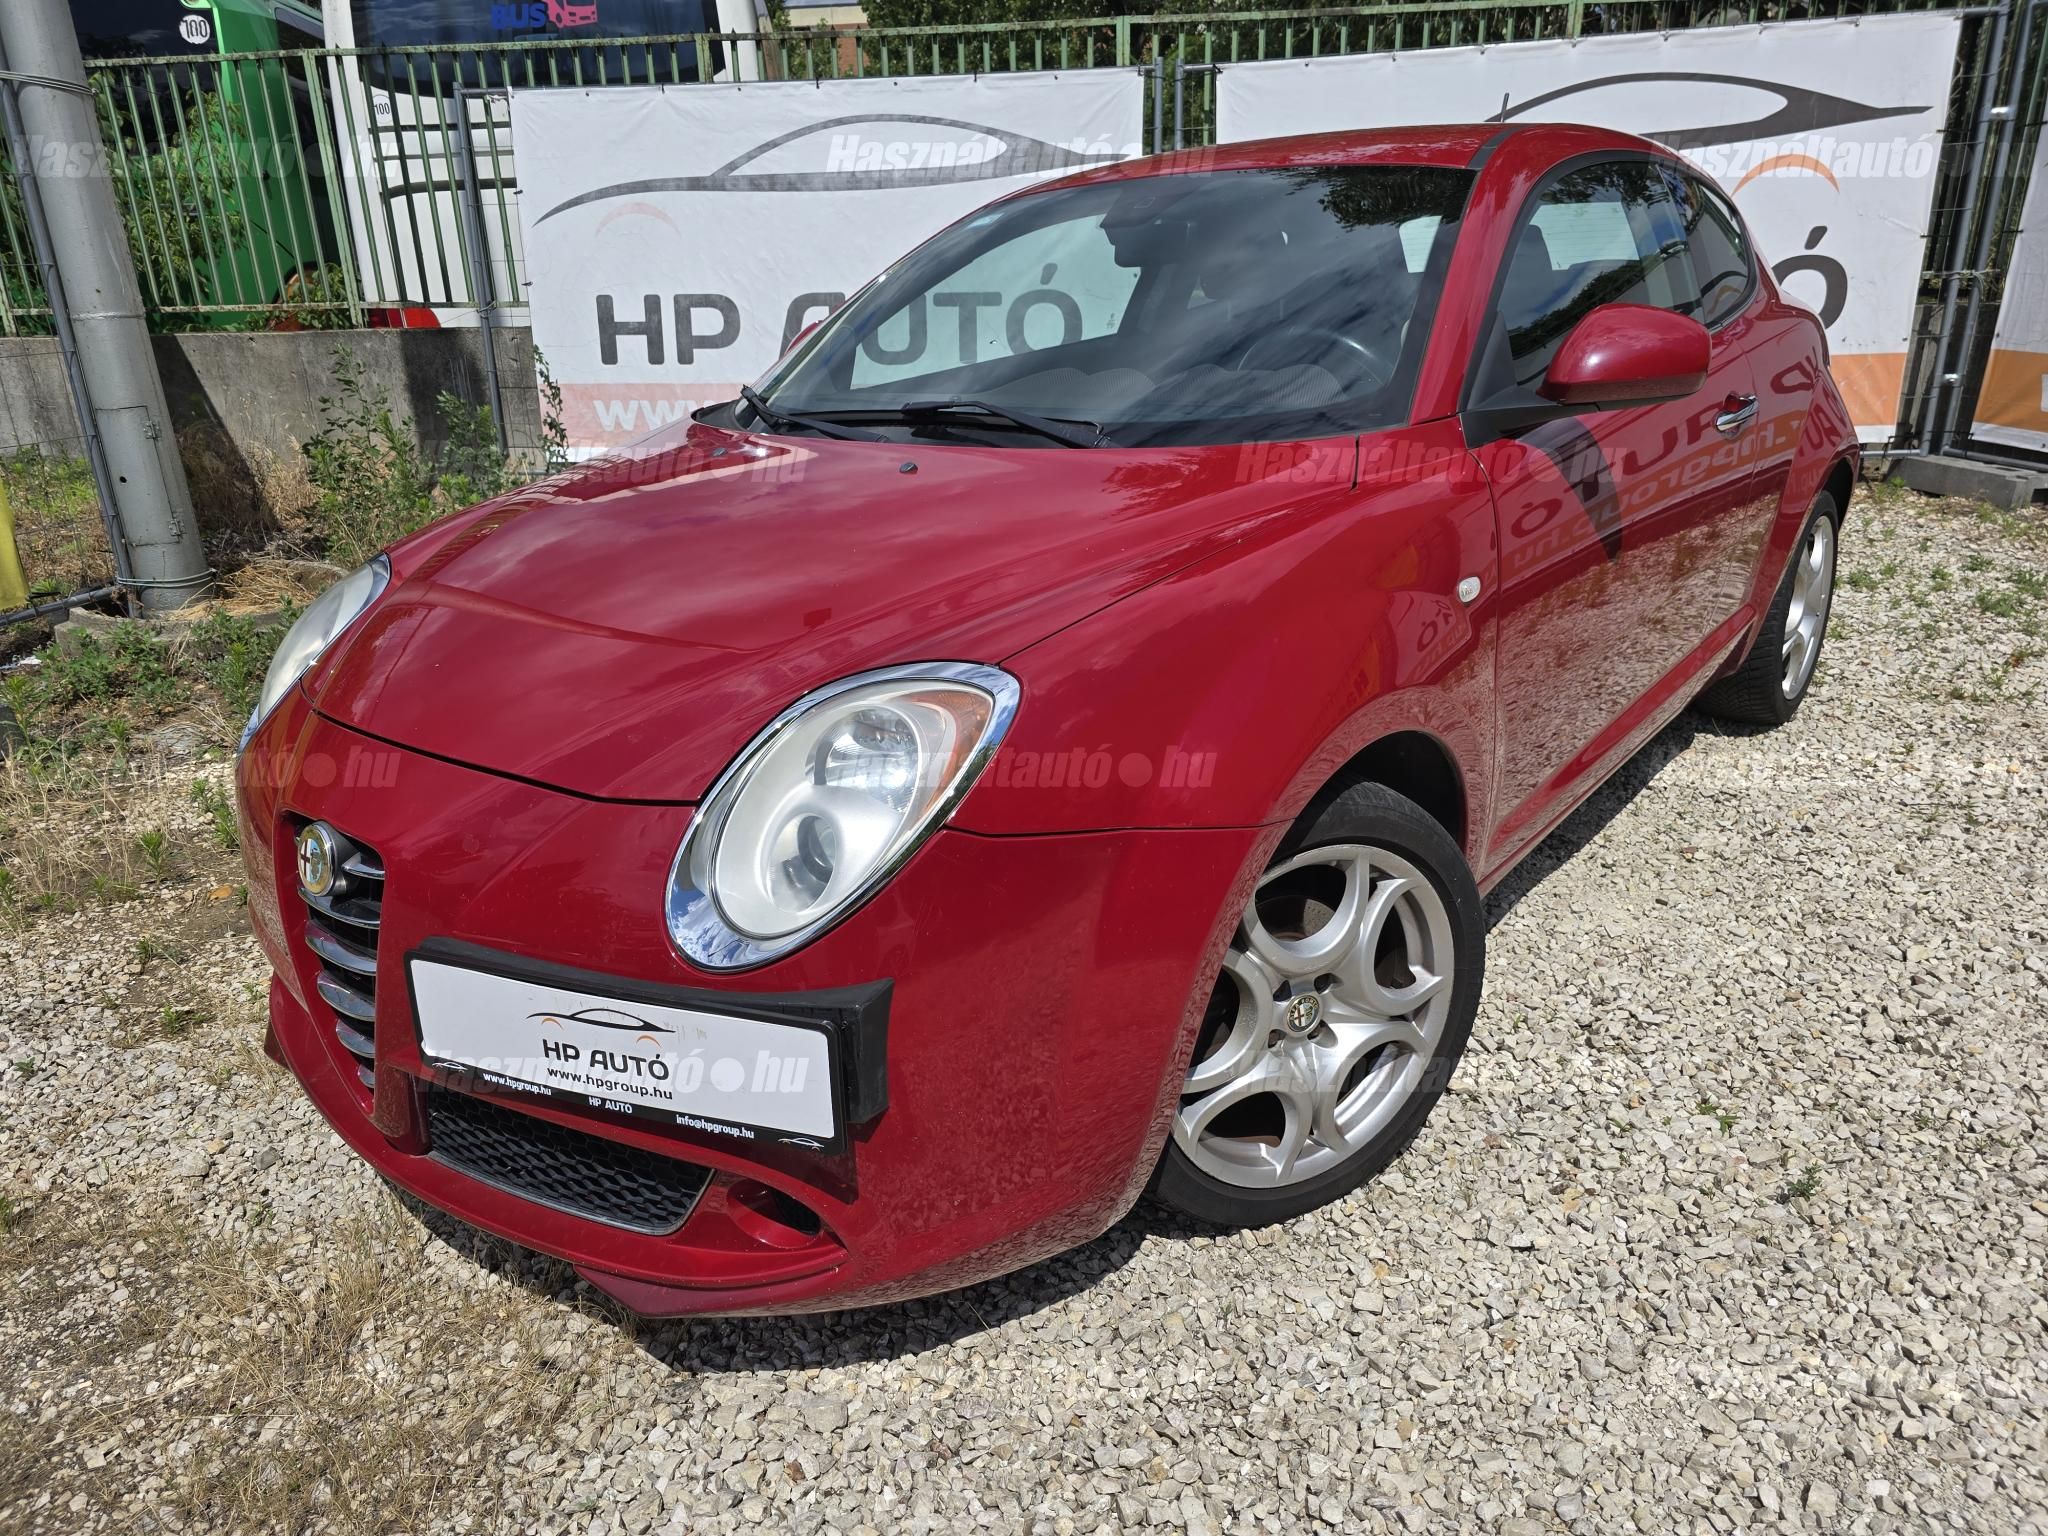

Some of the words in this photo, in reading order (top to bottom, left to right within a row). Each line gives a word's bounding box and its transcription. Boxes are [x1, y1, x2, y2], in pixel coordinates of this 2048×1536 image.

[491, 3, 547, 29] BUS
[181, 19, 208, 39] 100
[374, 102, 391, 115] 100
[596, 293, 741, 366] HP
[542, 1039, 580, 1062] HP
[590, 1054, 670, 1080] AUTÓ
[483, 1073, 552, 1096] www.hpgroup.hu
[547, 1067, 673, 1100] www.hpgroup.hu
[588, 1096, 602, 1107] HP
[676, 1114, 755, 1139] info@hpgroup.hu
